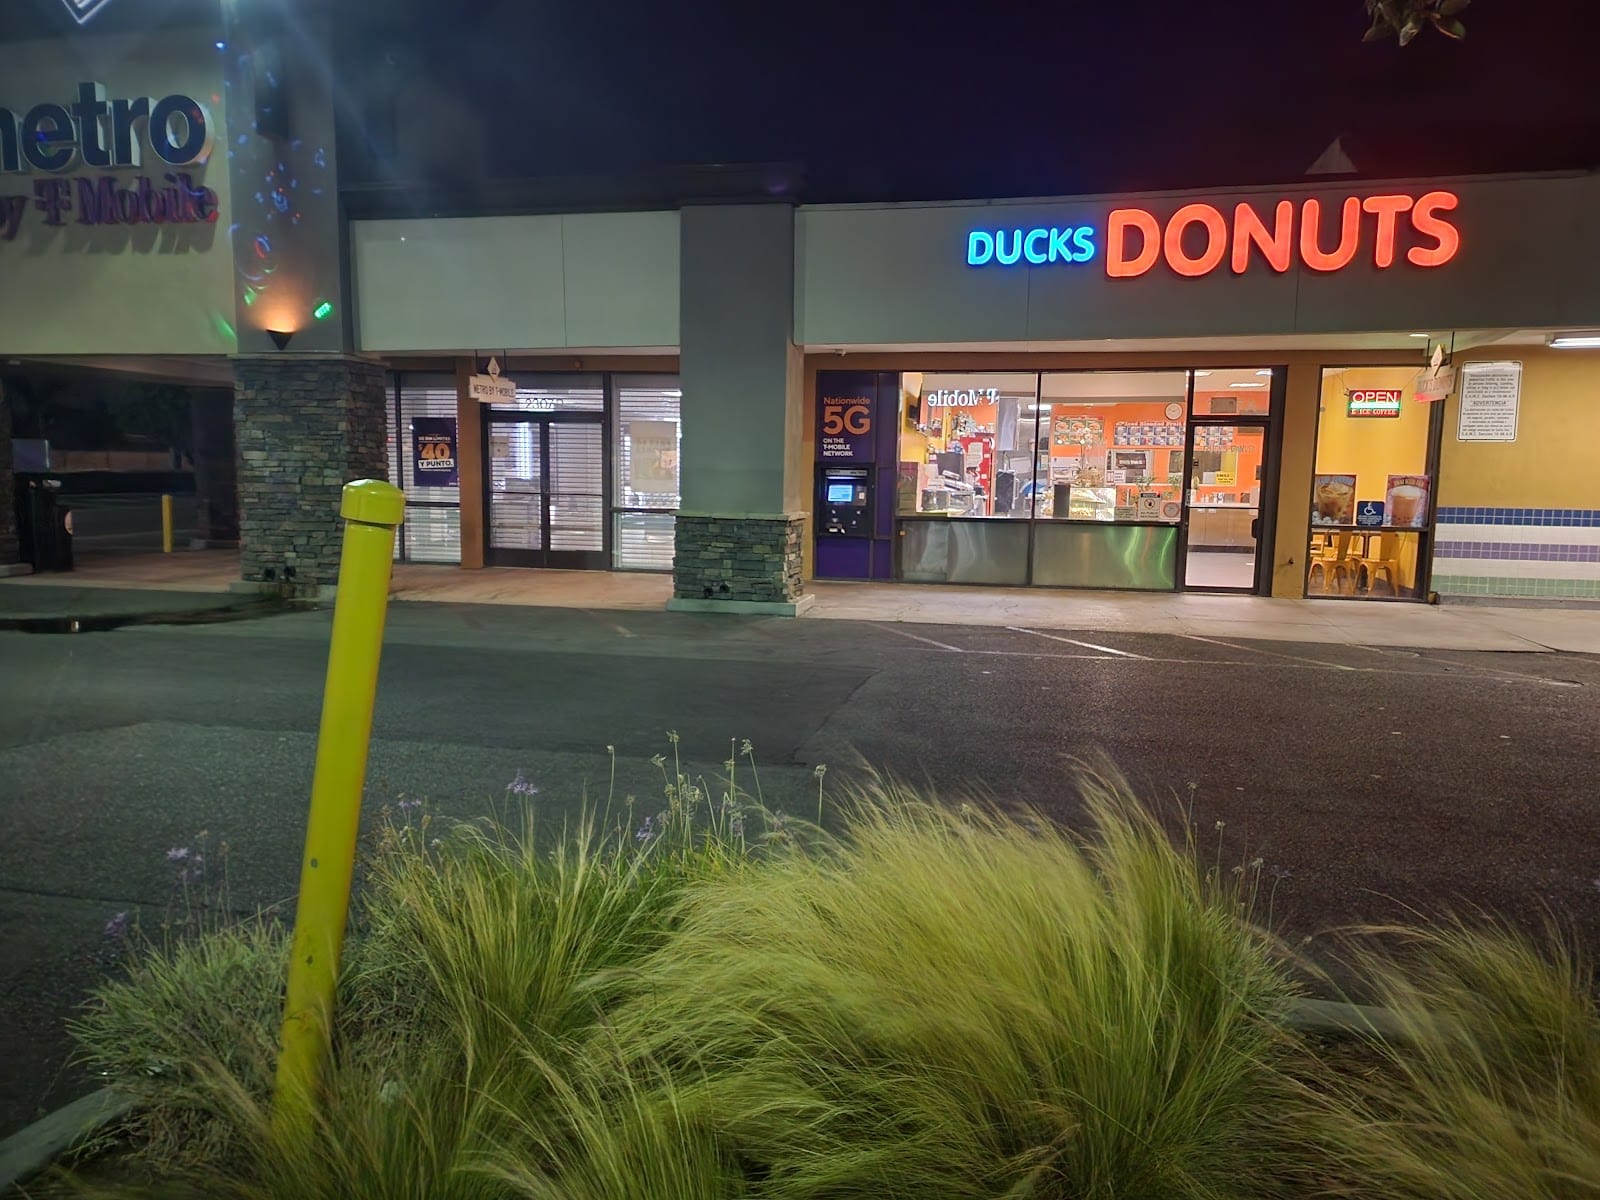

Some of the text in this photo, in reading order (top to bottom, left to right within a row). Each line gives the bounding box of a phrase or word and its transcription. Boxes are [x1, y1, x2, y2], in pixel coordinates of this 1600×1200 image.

[0, 82, 210, 171] etro
[0, 195, 28, 241] y
[73, 171, 219, 225] Mobile
[967, 191, 1459, 278] DUCKS DONUTS
[473, 384, 488, 395] METRO
[823, 396, 871, 405] Nationwide
[1352, 391, 1398, 404] OPEN
[823, 405, 871, 435] 5G
